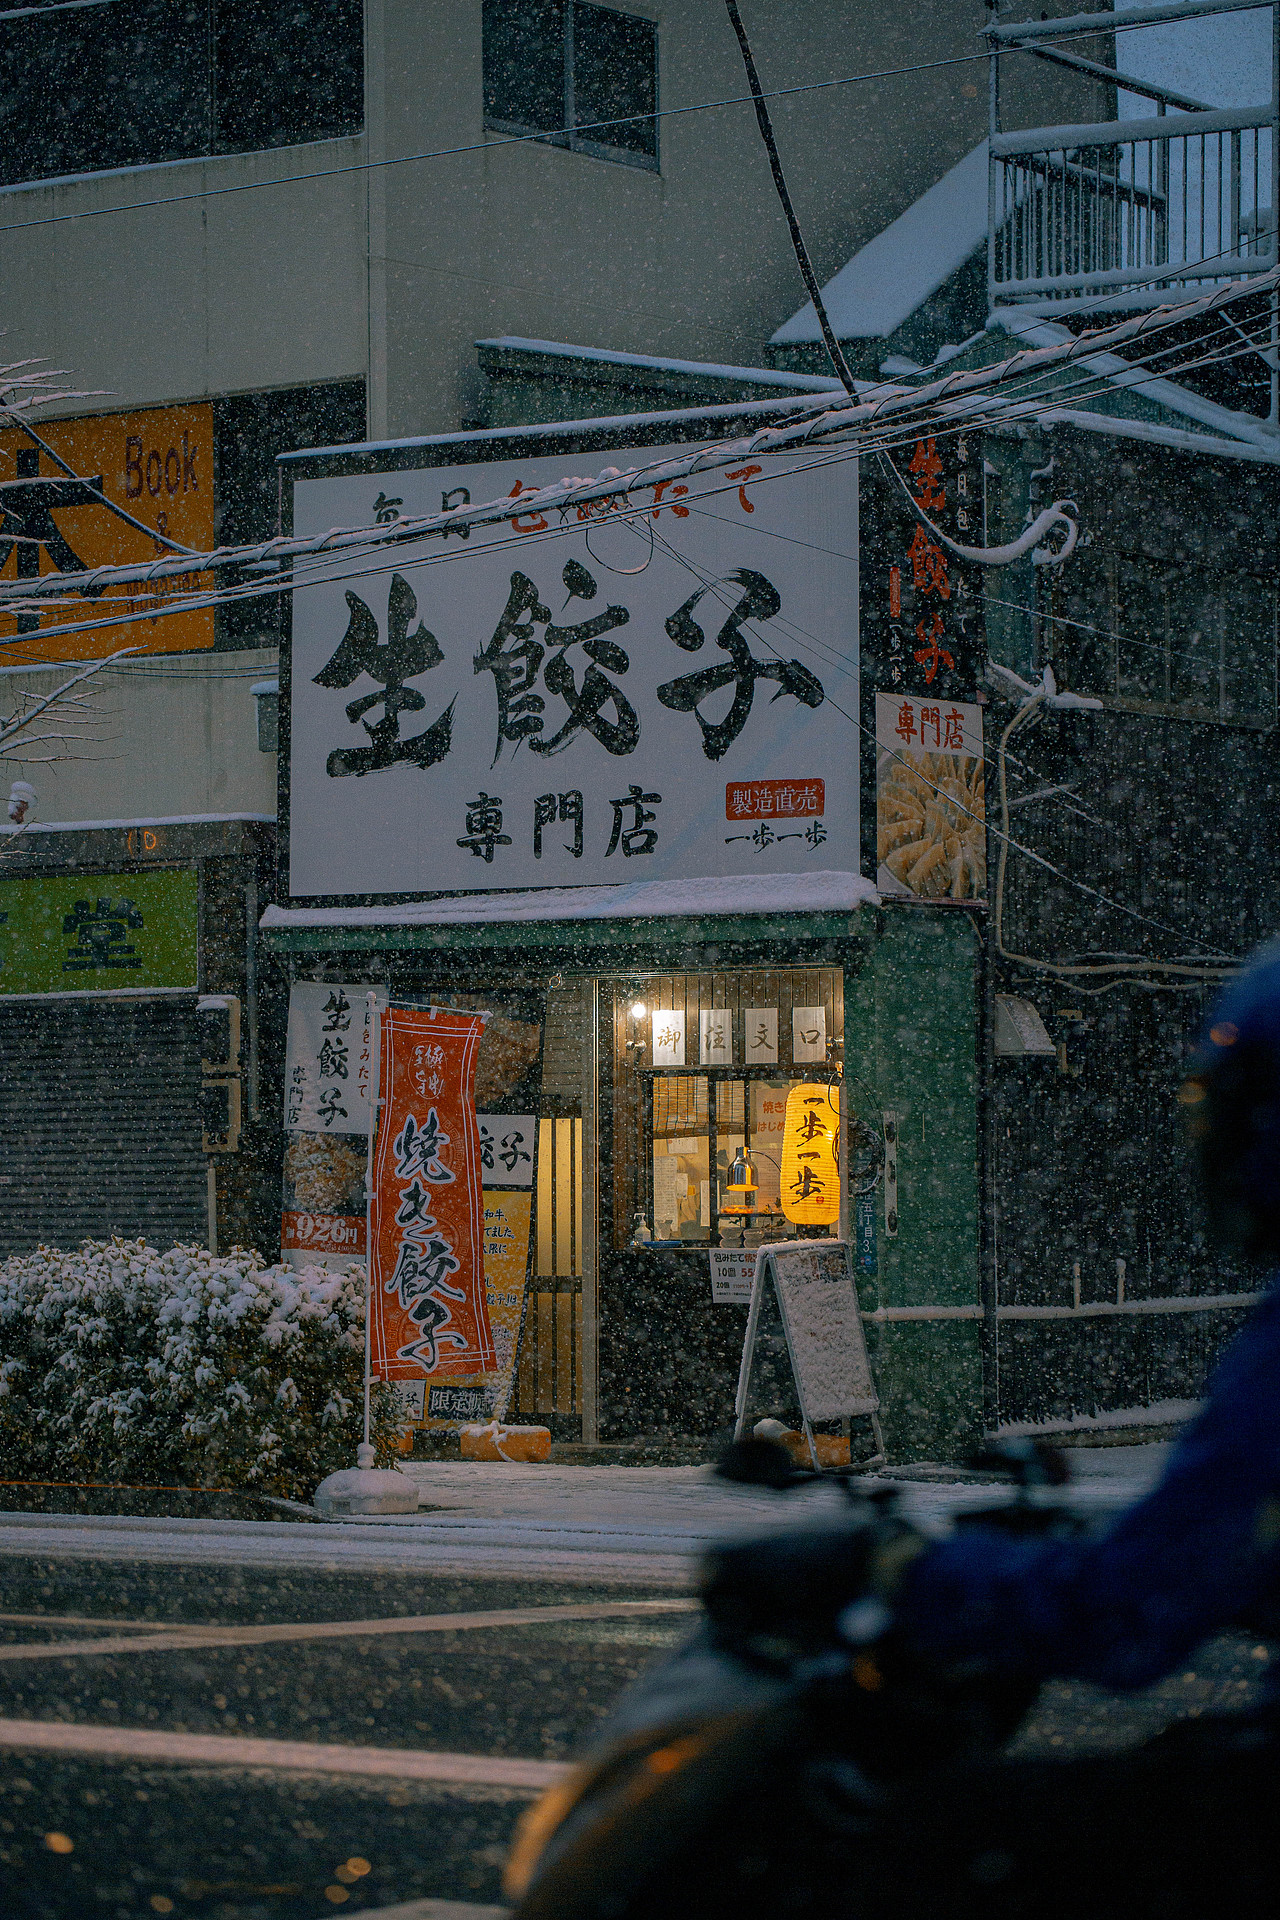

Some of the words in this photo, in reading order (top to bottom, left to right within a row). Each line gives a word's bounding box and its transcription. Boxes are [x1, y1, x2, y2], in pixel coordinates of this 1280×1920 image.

[126, 430, 200, 499] Book
[154, 511, 171, 554] &
[907, 435, 955, 685] 生餃子
[312, 558, 825, 778] 生餃子
[895, 701, 965, 750] 専門店
[456, 784, 663, 864] 専門店
[732, 787, 818, 814] 製造直売
[724, 820, 829, 853] 一歩一歩
[62, 897, 144, 972] 堂
[317, 988, 352, 1127] 生餃子
[657, 1024, 820, 1053] 御注文口
[762, 1100, 787, 1114] 焼き
[790, 1097, 828, 1205] 一歩一歩
[386, 1107, 466, 1372] 焼き餃子
[741, 1268, 756, 1278] 55
